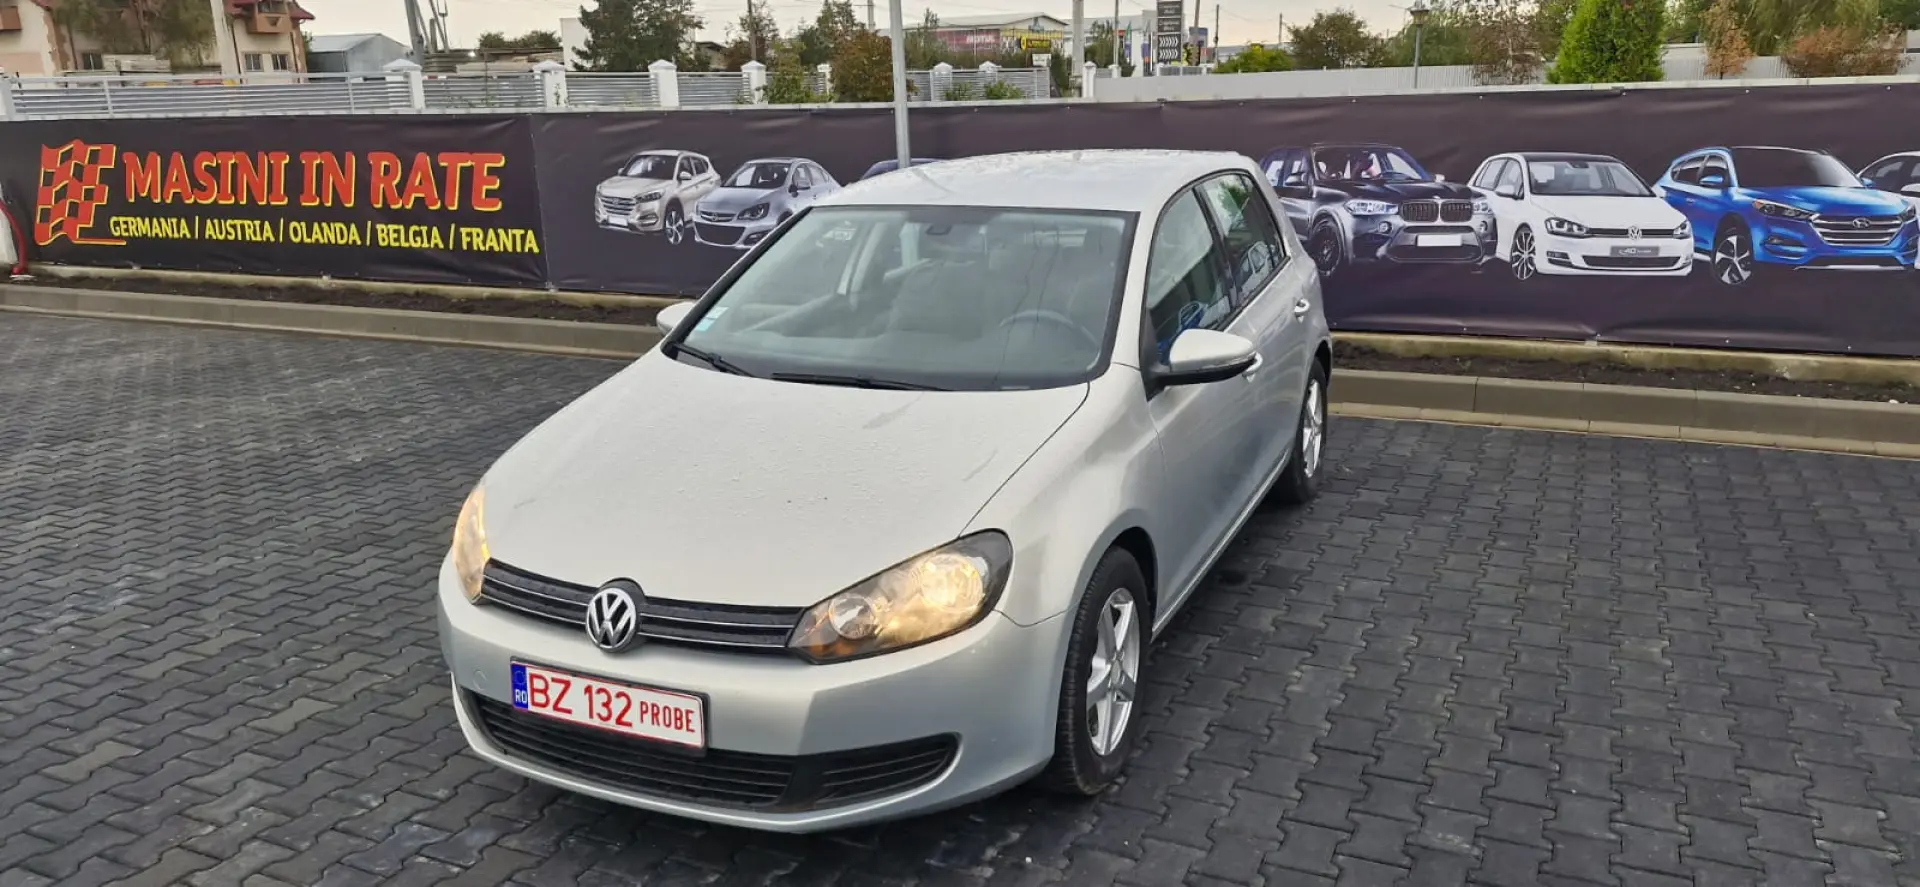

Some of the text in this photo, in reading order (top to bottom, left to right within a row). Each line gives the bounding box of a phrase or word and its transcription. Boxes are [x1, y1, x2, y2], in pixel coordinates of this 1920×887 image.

[122, 151, 505, 212] MASINI IN RATE
[109, 215, 192, 239] GERMANIA
[204, 218, 275, 242] AUSTRIA
[288, 221, 362, 246] OLANDA
[375, 223, 444, 249] BELGIA
[459, 227, 540, 253] FRANTA
[515, 673, 696, 733] RO BZ 132 PROBE
